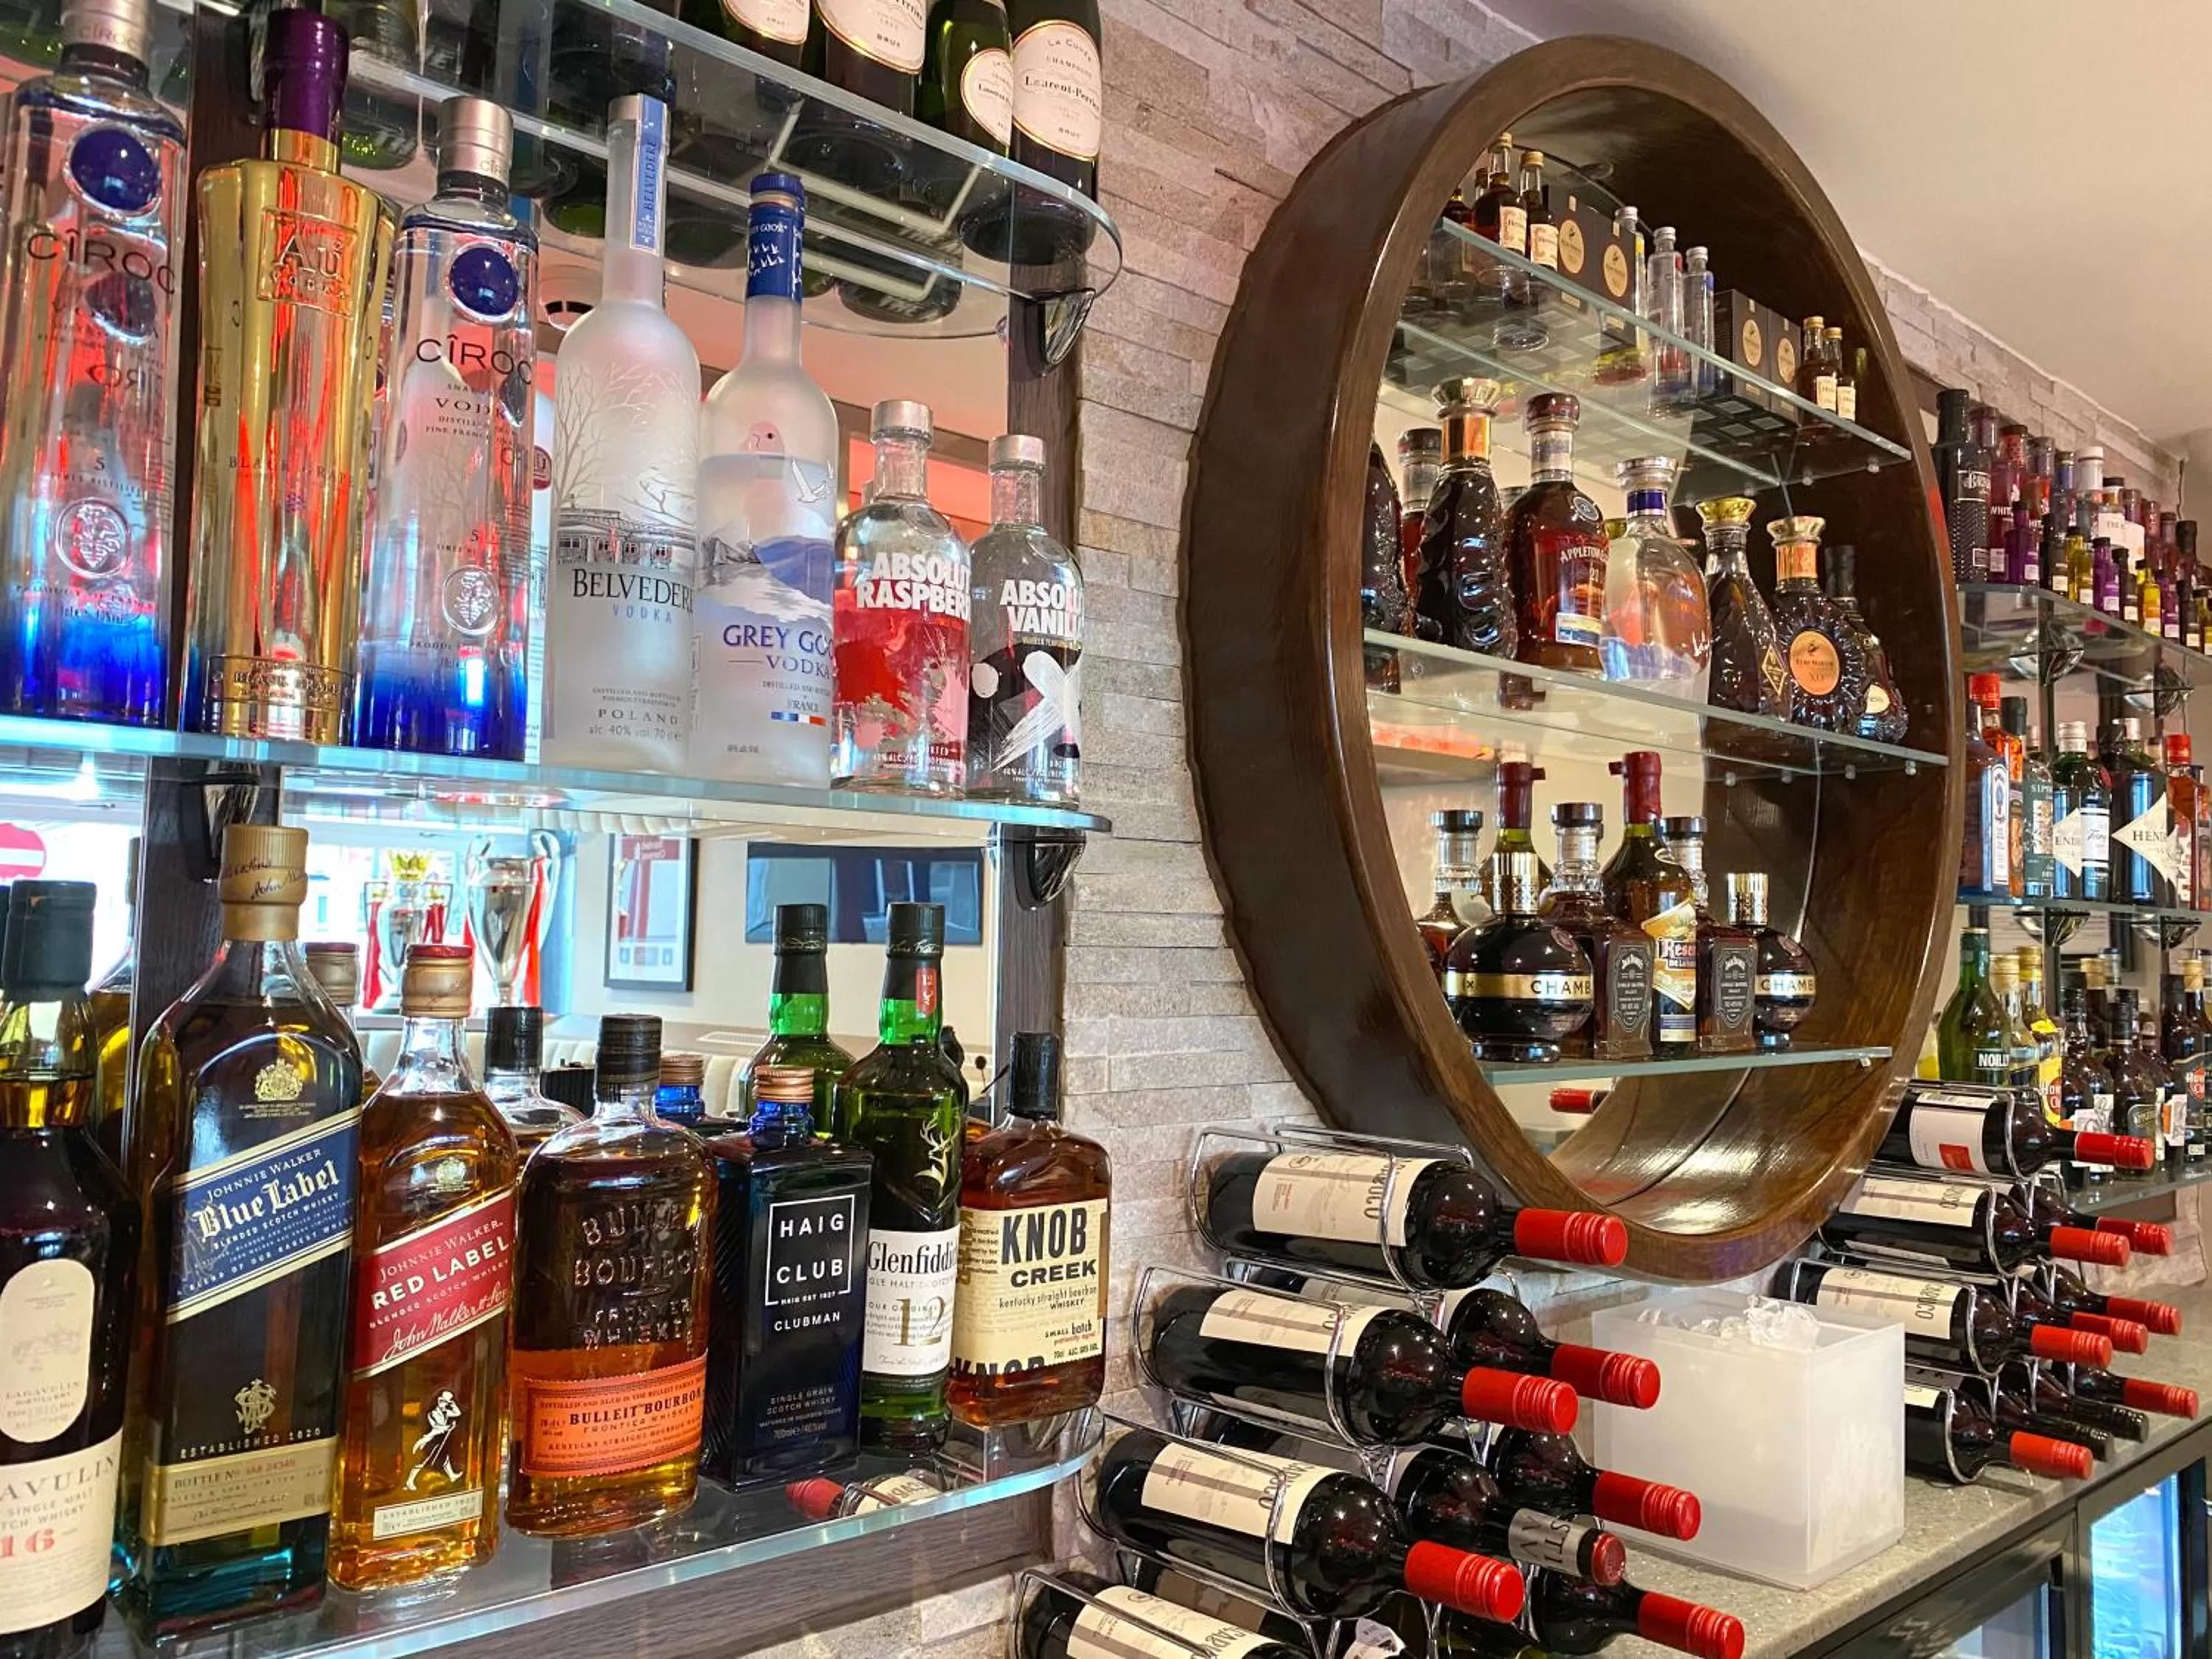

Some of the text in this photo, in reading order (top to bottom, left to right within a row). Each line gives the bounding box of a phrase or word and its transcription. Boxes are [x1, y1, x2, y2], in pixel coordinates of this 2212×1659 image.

[417, 334, 532, 385] CÎROC
[613, 603, 672, 625] VODKA
[723, 624, 790, 650] GREY
[766, 655, 830, 680] VODKA
[598, 708, 678, 727] POLAND
[1530, 980, 1591, 995] CHAMB
[1760, 978, 1813, 992] CHAMB
[206, 1148, 321, 1203] JOHNNIE WALKER
[191, 1159, 341, 1243] Blue Label
[262, 1208, 299, 1230] SCOTCH
[780, 1213, 845, 1238] HAIG
[1001, 1207, 1088, 1265] KNOB
[380, 1220, 499, 1284] JOHNNIE WALKER
[868, 1240, 956, 1275] Glenfiddi
[371, 1236, 509, 1310] RED LABEL
[776, 1259, 843, 1284] CLUB
[1010, 1259, 1097, 1287] CREEK
[890, 1279, 914, 1290] MALT
[999, 1293, 1036, 1309] kentucky
[1050, 1297, 1085, 1310] WHISKEY
[774, 1311, 841, 1332] CLUBMAN
[892, 1295, 946, 1348] 12
[1045, 1319, 1092, 1338] SMALL batch
[569, 1405, 638, 1425] BULLEIT
[766, 1404, 802, 1416] SCOTCH
[181, 1427, 321, 1460] ESTABLISHED 1820
[0, 1455, 114, 1502] AVULIN
[8, 1499, 57, 1517] SINGLE
[0, 1519, 29, 1531] TCH
[1, 1528, 55, 1558] 16
